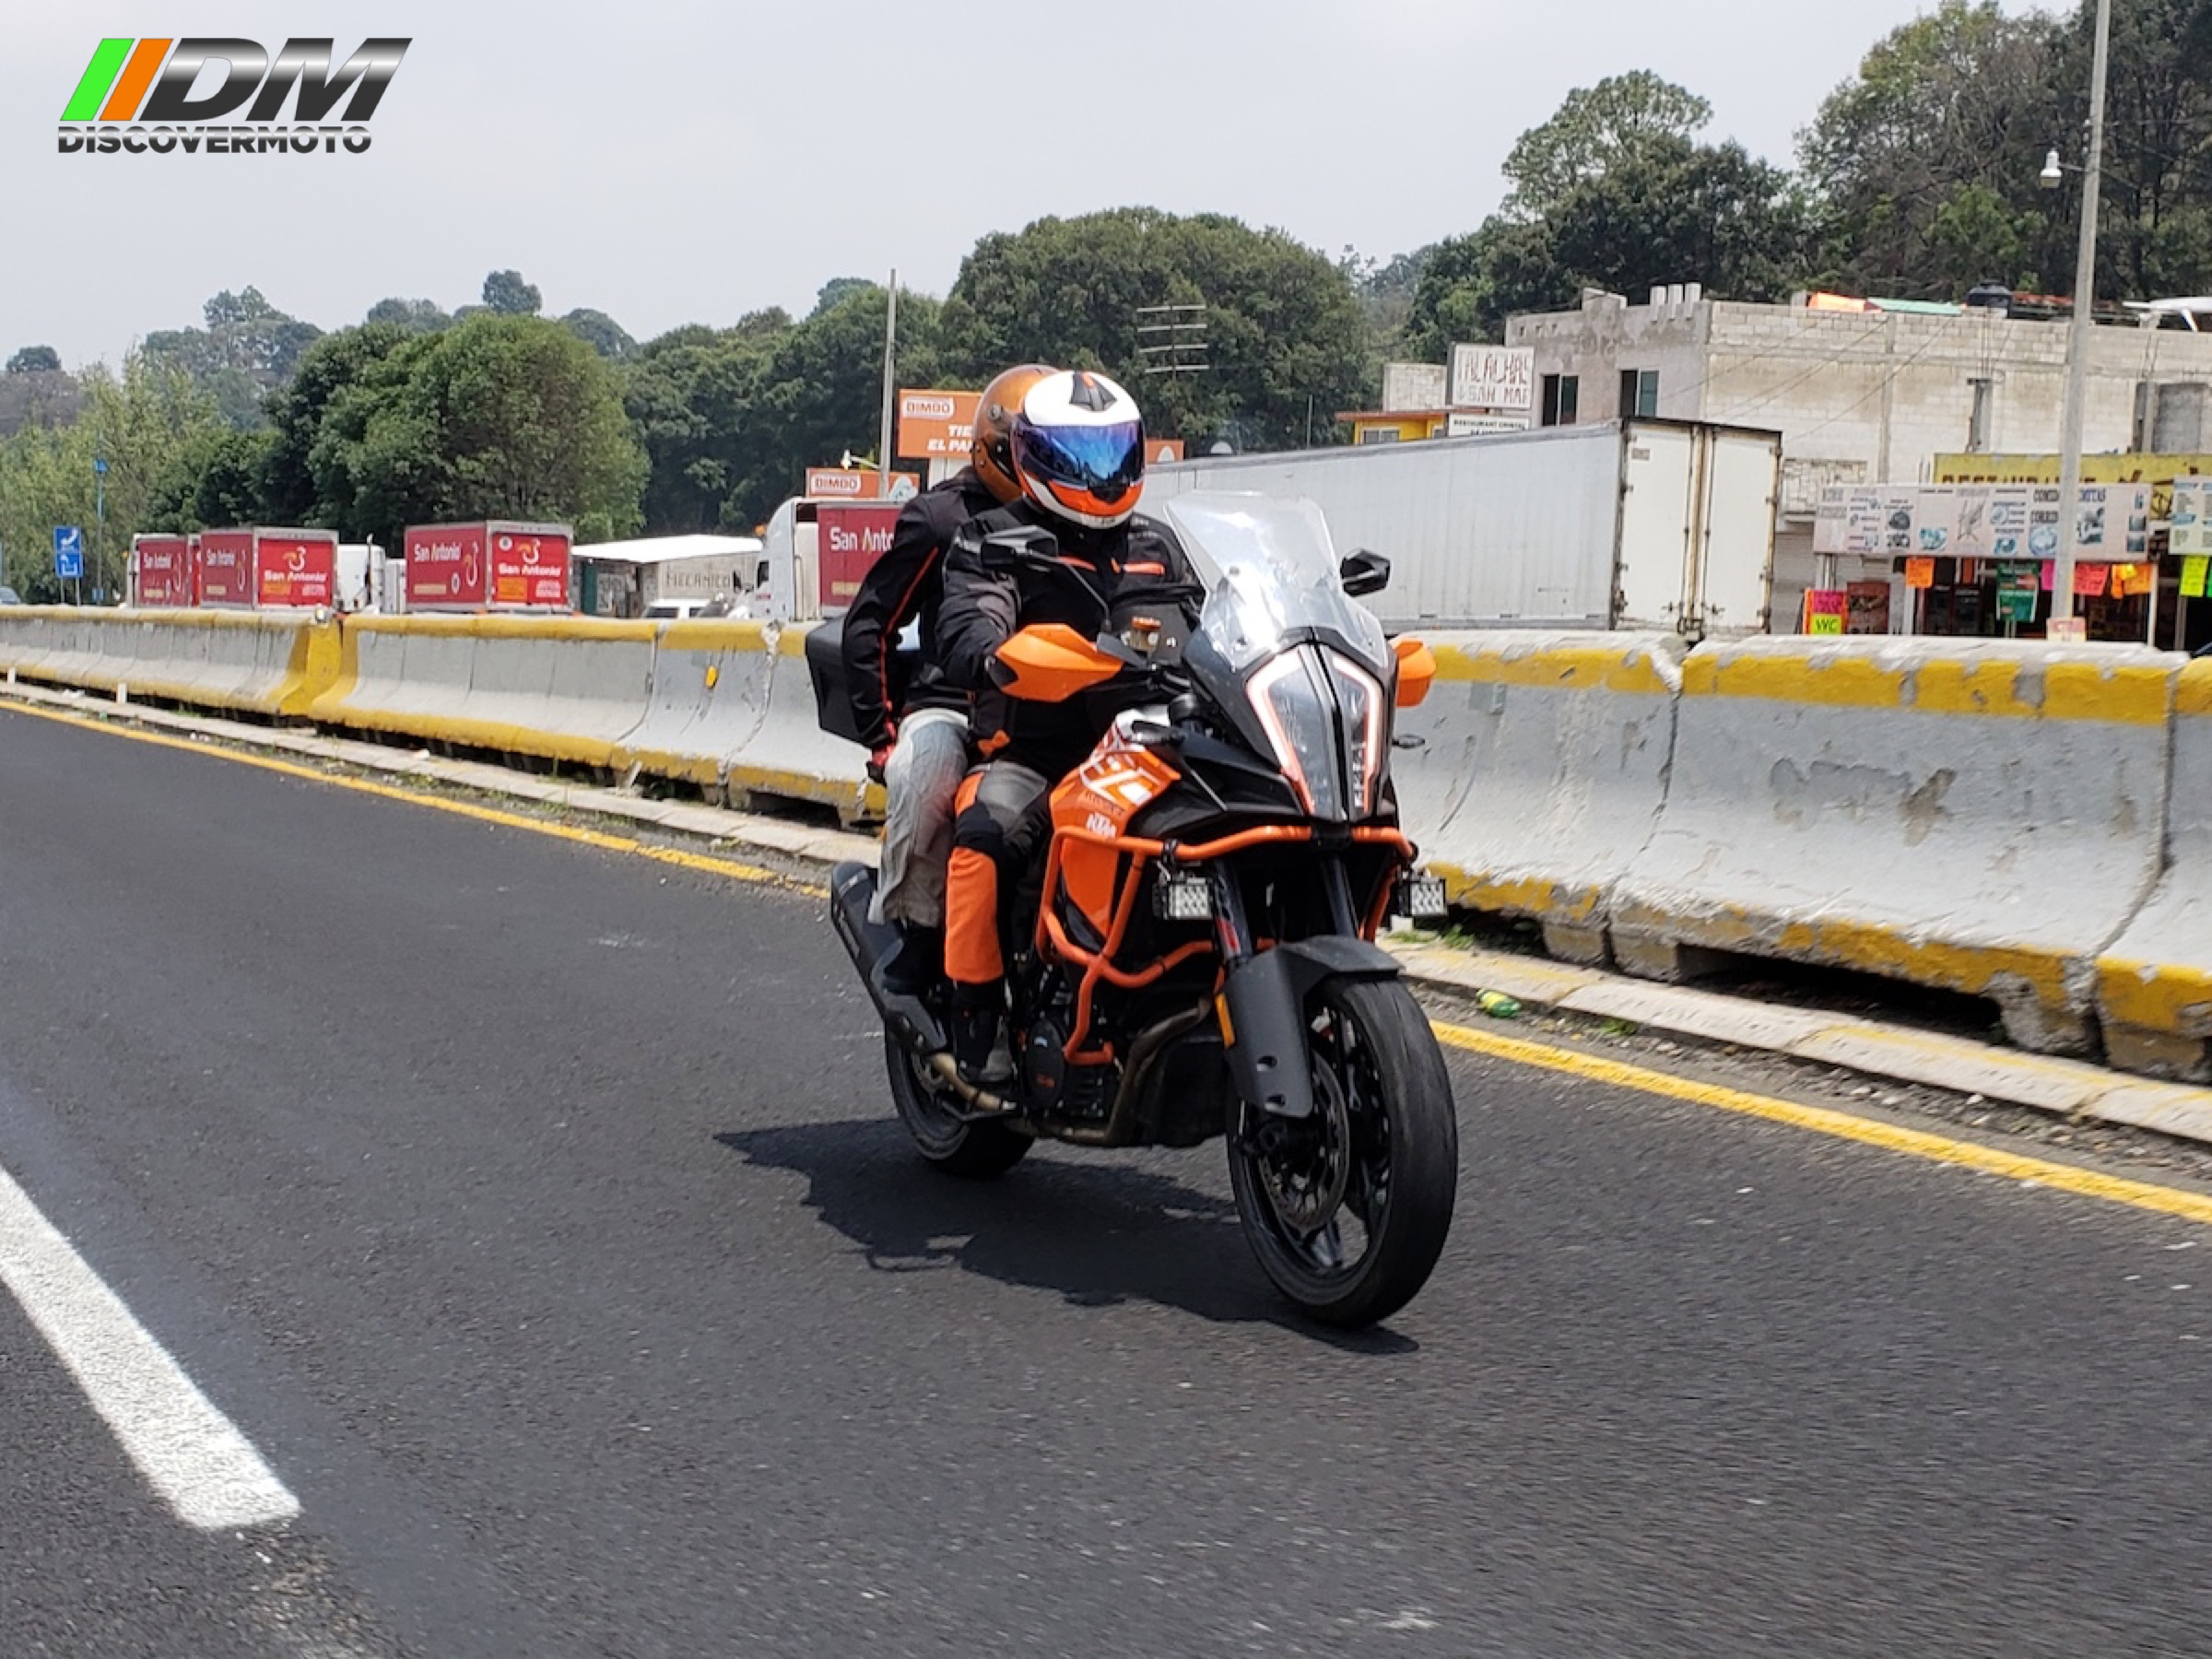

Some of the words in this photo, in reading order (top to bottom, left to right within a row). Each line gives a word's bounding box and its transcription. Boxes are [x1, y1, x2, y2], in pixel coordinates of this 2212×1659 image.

[947, 425, 973, 438] TIE
[927, 438, 946, 451] EL
[830, 526, 857, 551] San
[863, 526, 894, 553] Anto
[415, 543, 430, 562] San
[431, 541, 461, 562] Antonio
[498, 562, 520, 574] San
[521, 564, 561, 576] Antonio
[1816, 619, 1839, 632] WC
